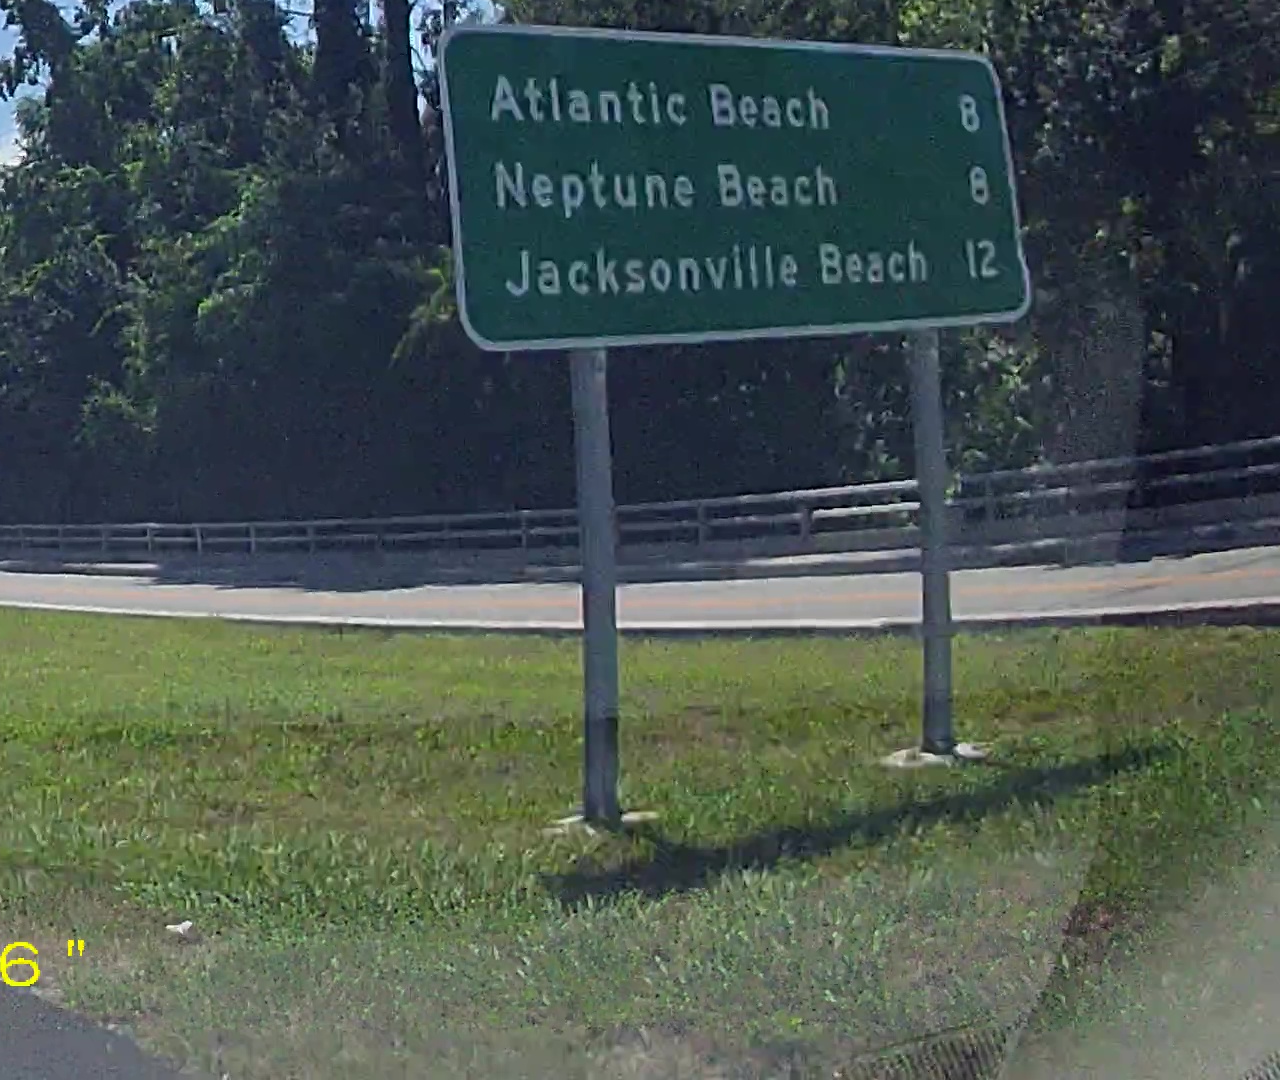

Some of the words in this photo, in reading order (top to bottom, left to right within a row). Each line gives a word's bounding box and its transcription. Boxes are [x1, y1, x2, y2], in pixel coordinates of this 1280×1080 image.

[491, 75, 686, 126] Atlantic
[711, 84, 831, 130] Beach
[959, 95, 980, 133] 8
[495, 160, 696, 218] Neptune
[717, 164, 838, 207] Beach
[969, 168, 990, 205] 8
[505, 245, 798, 297] Jacksonville
[820, 240, 928, 285] Beach
[965, 240, 999, 279] 12
